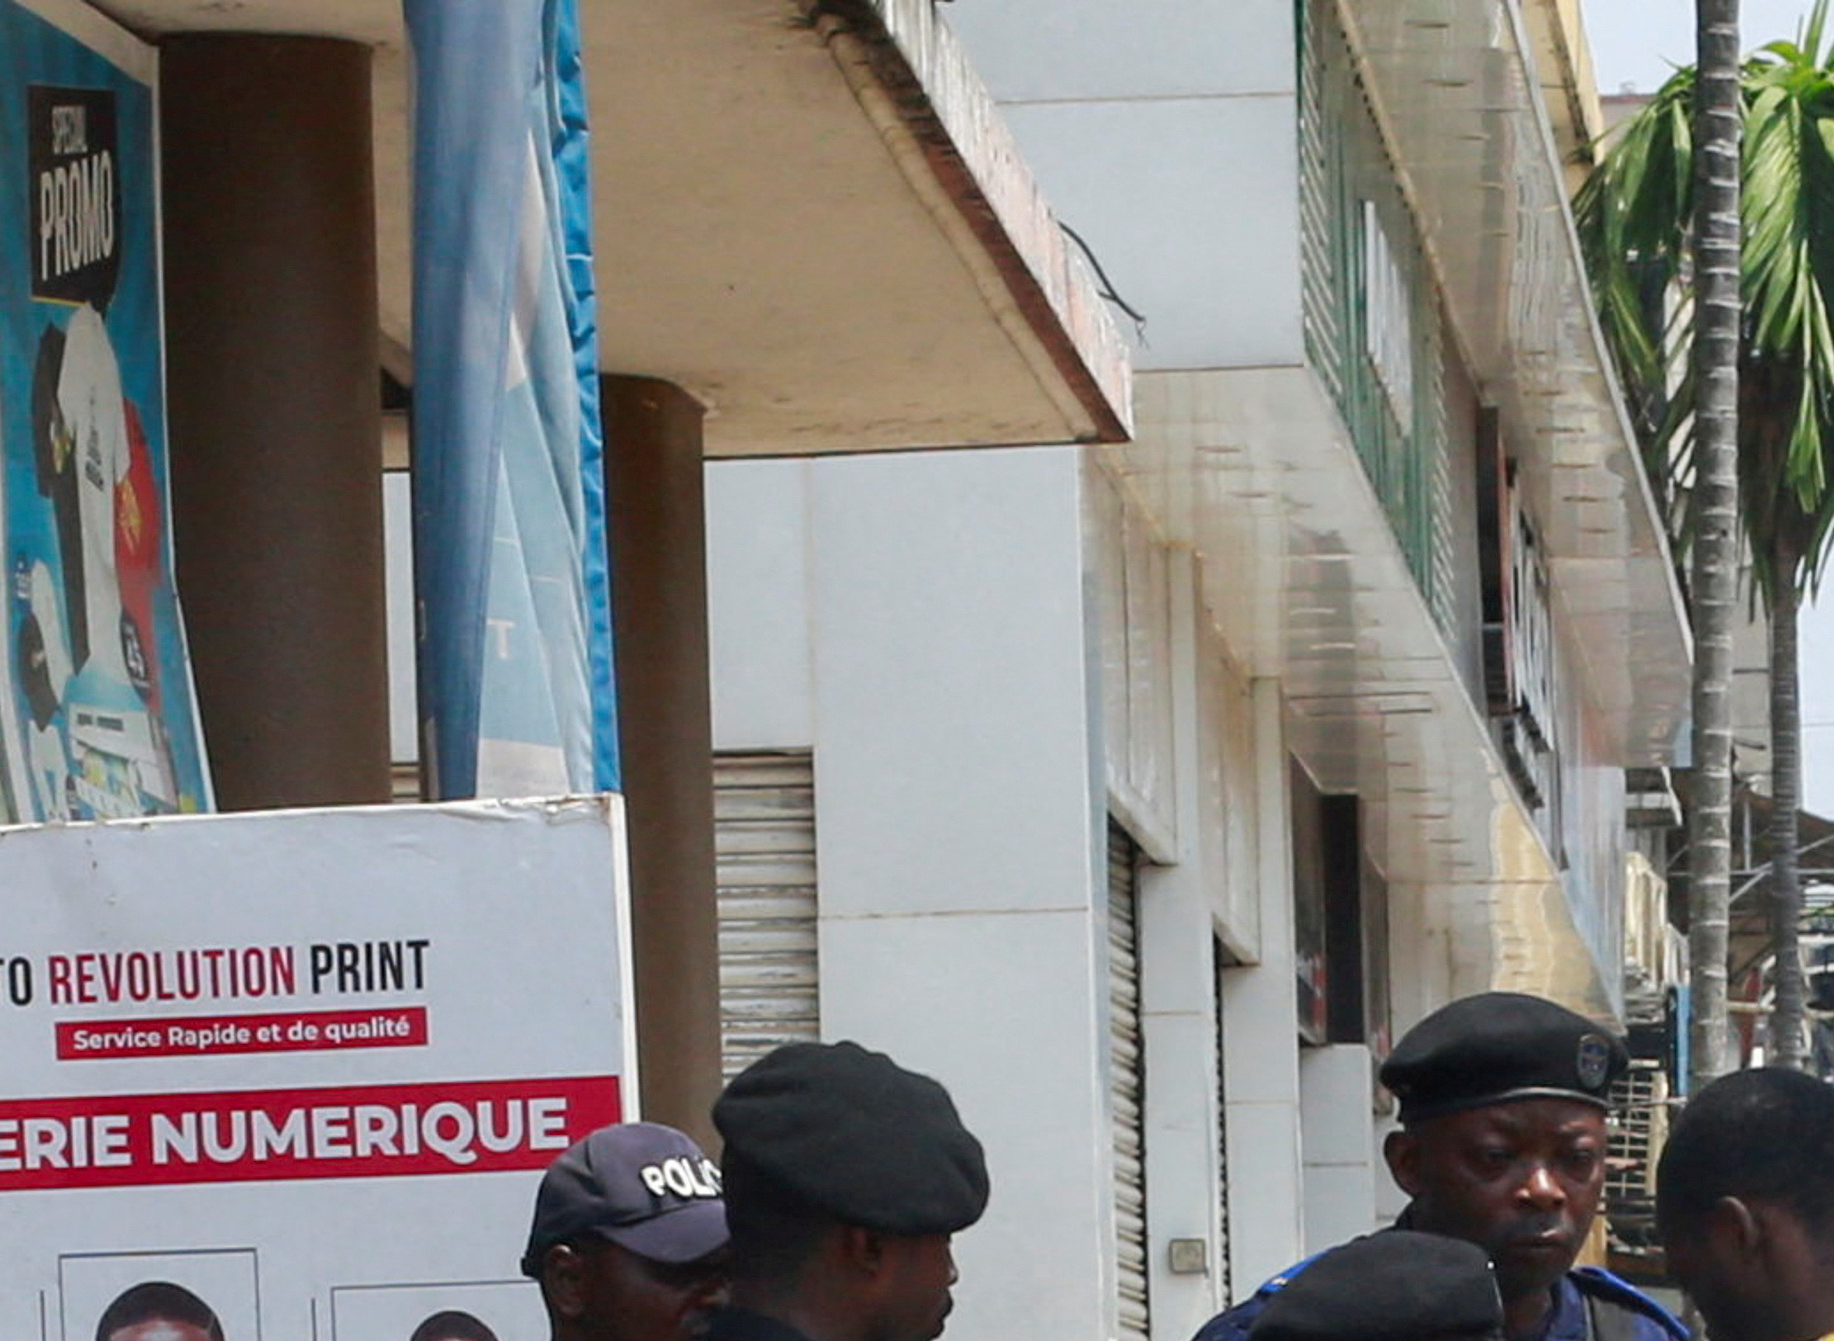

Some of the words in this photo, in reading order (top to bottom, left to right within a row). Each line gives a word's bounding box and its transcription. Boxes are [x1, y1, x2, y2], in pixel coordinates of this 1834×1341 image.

[40, 150, 114, 281] PROMO
[48, 945, 296, 1006] REVOLUTION
[310, 939, 431, 993] PRINT
[73, 1026, 162, 1051] Service
[168, 1022, 252, 1052] Rapide
[257, 1023, 282, 1043] et
[288, 1018, 319, 1042] de
[325, 1013, 411, 1045] qualité
[152, 1096, 569, 1166] NUMERIQUE
